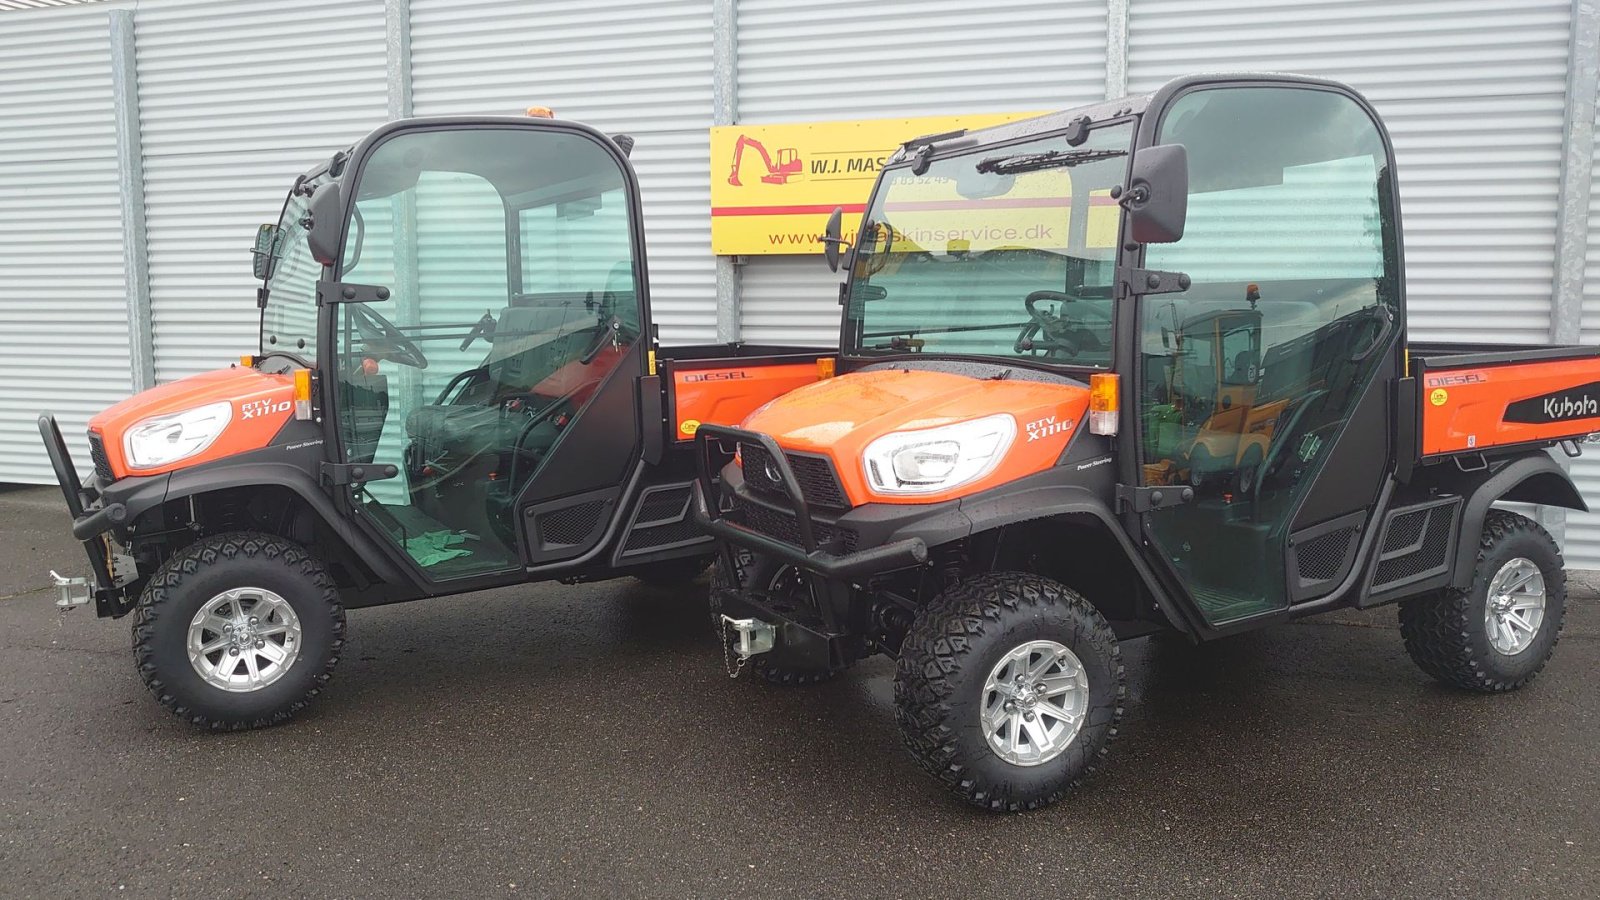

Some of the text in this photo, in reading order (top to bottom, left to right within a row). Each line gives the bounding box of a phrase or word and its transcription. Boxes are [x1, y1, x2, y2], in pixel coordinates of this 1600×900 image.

[811, 159, 841, 174] W.J.
[769, 224, 1052, 246] wwwjaskinservice.dk
[685, 371, 753, 383] DIESEL
[1428, 374, 1486, 388] DIESEL
[242, 398, 272, 411] RTV
[242, 401, 291, 420] X1110
[1544, 395, 1597, 419] Kubota
[1026, 416, 1055, 432] RTV
[1077, 458, 1112, 471] Power Steering
